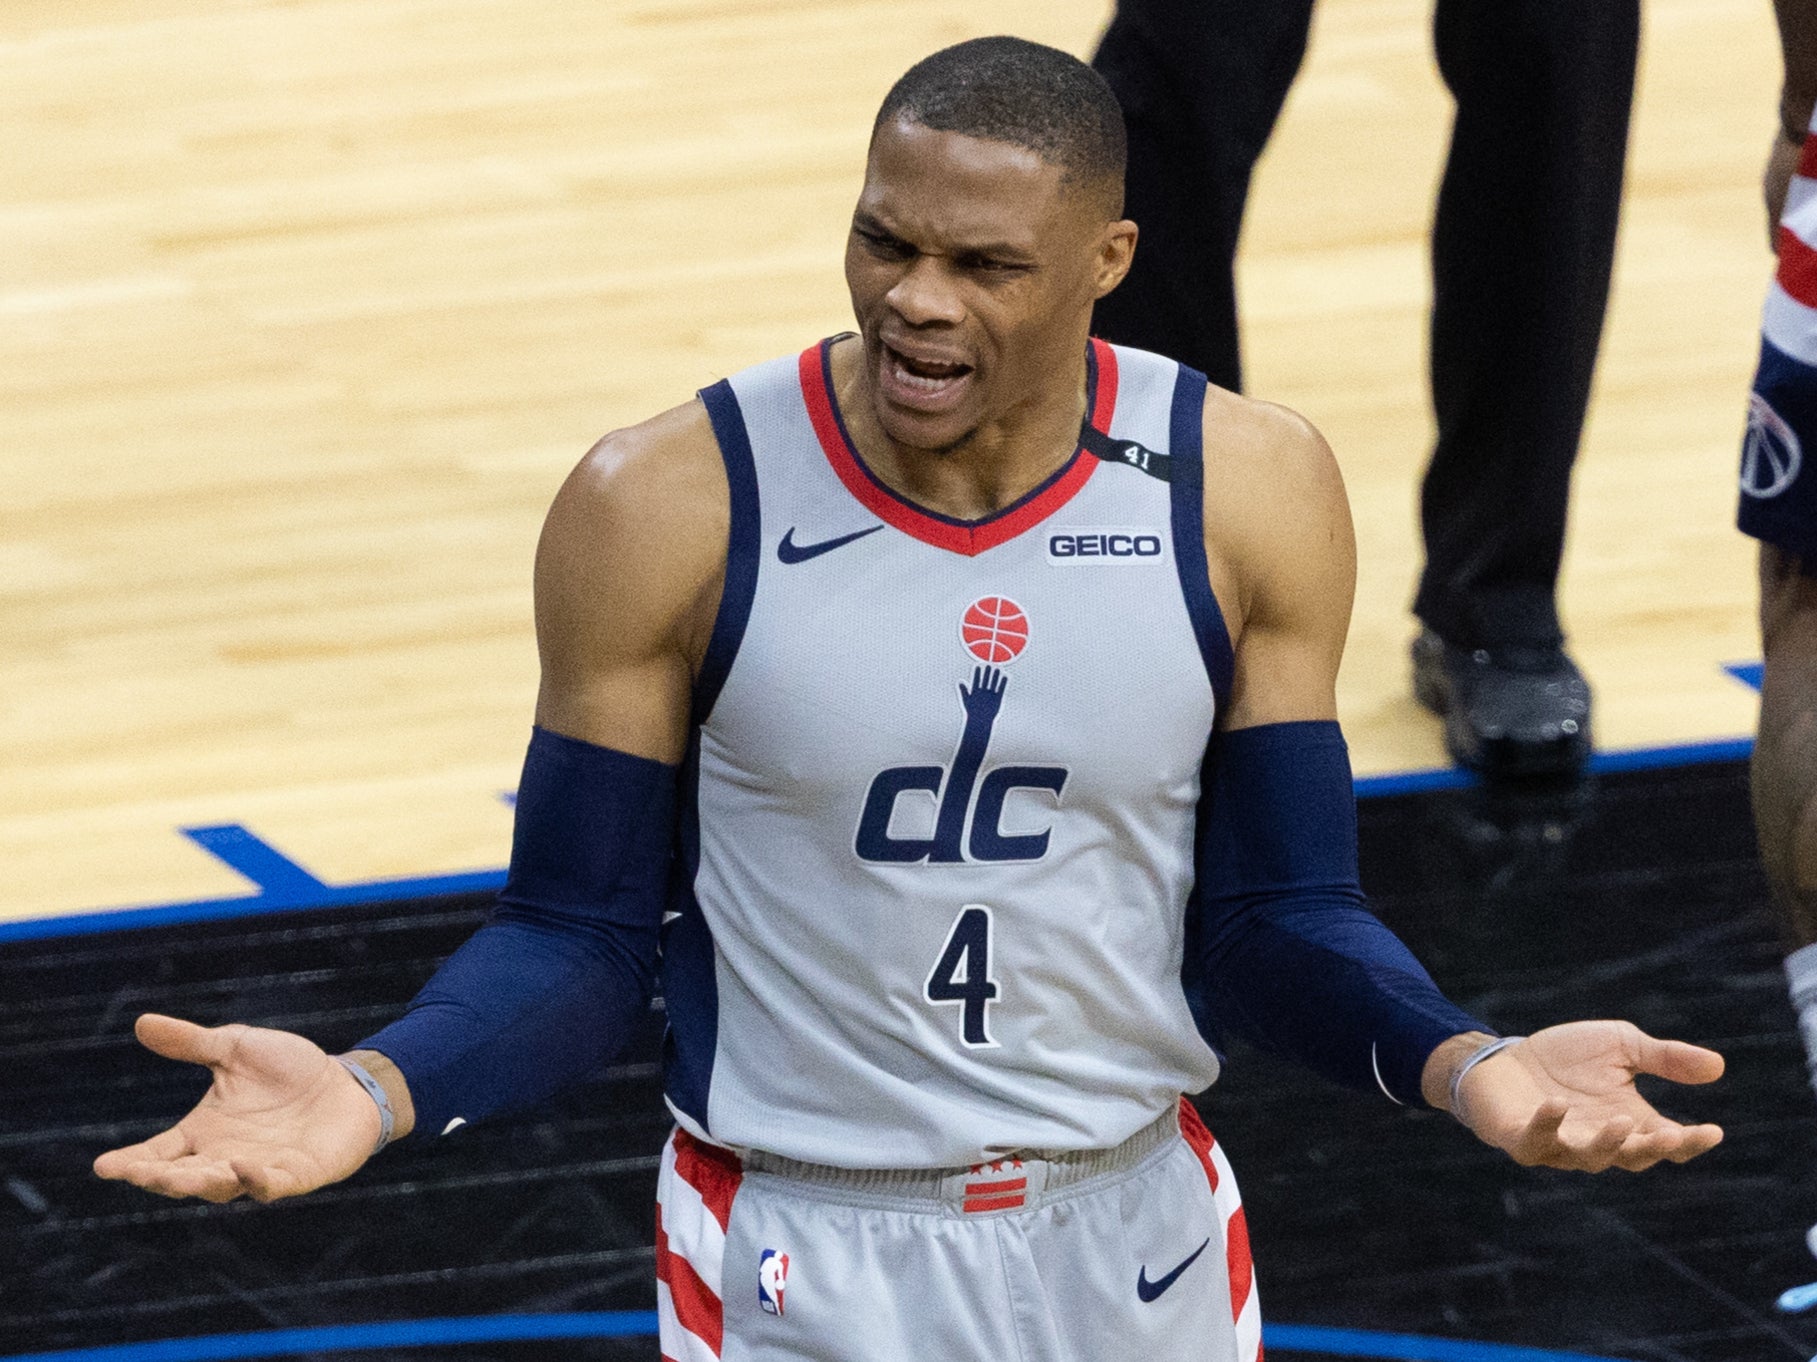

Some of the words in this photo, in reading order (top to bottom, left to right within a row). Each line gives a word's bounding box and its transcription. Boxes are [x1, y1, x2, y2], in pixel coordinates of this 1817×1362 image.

[1124, 445, 1149, 470] 41
[1049, 534, 1162, 557] GEICO
[855, 665, 1069, 863] dc
[923, 904, 1002, 1050] 4
